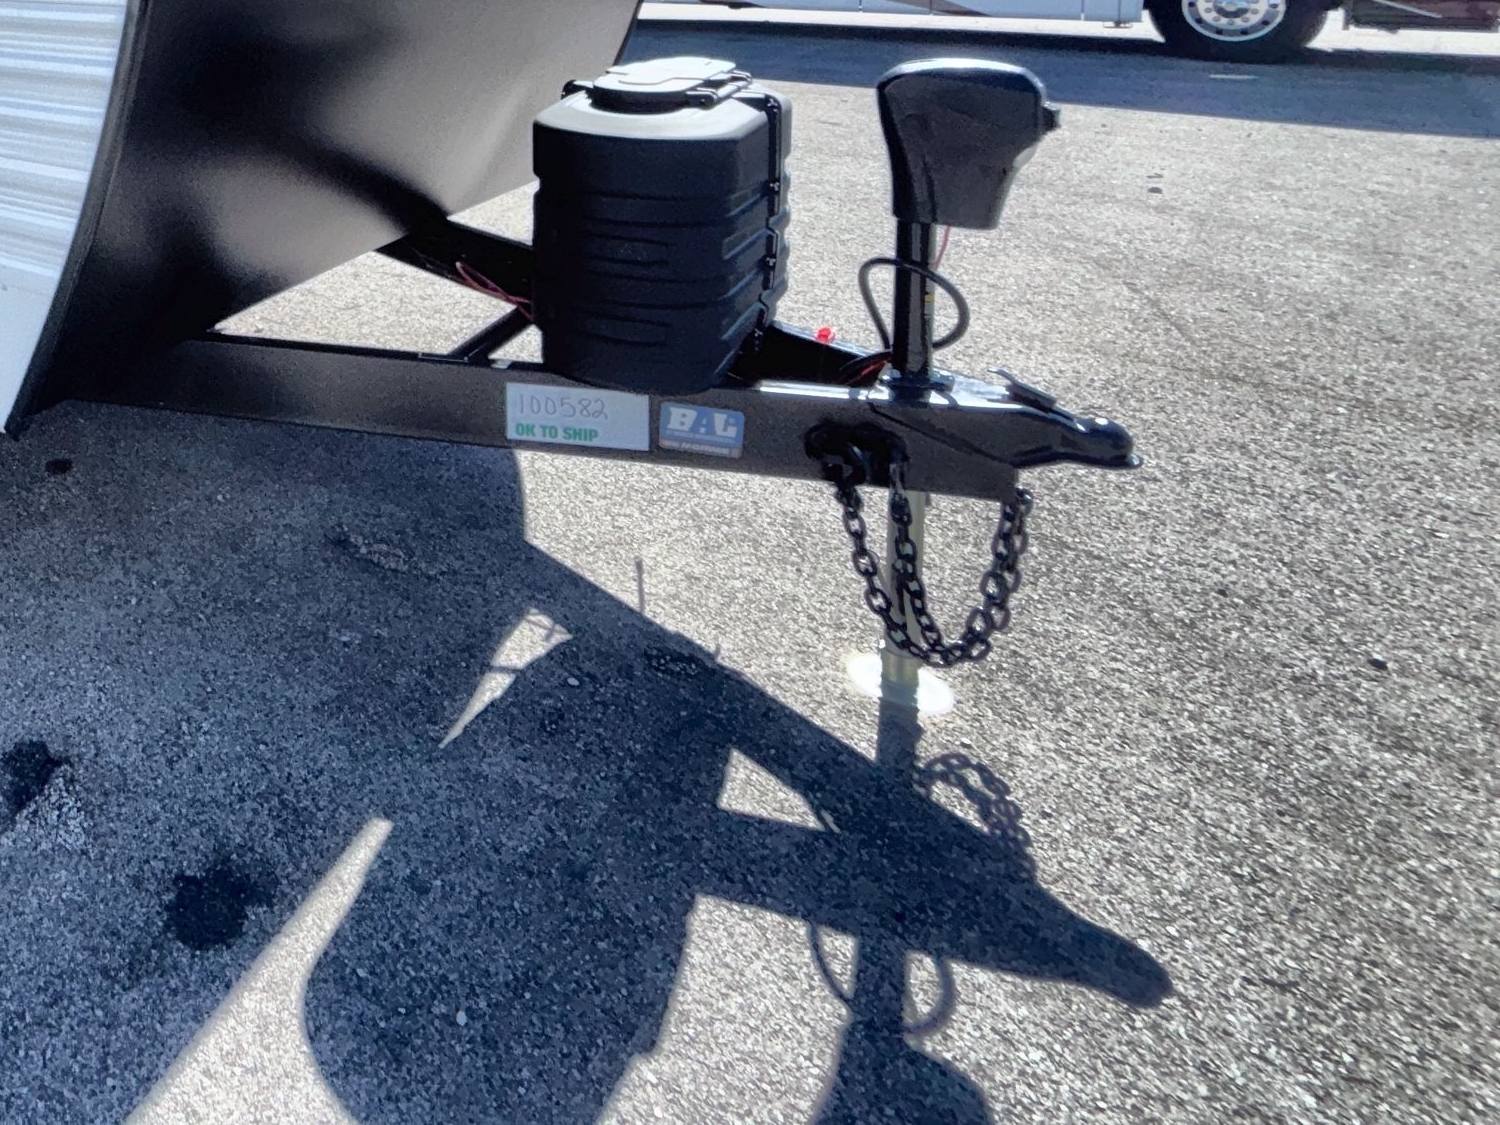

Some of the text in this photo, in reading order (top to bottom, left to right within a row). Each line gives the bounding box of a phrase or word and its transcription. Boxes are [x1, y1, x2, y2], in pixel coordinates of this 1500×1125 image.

[519, 394, 608, 420] 100582
[515, 422, 599, 442] OK TO SHIP
